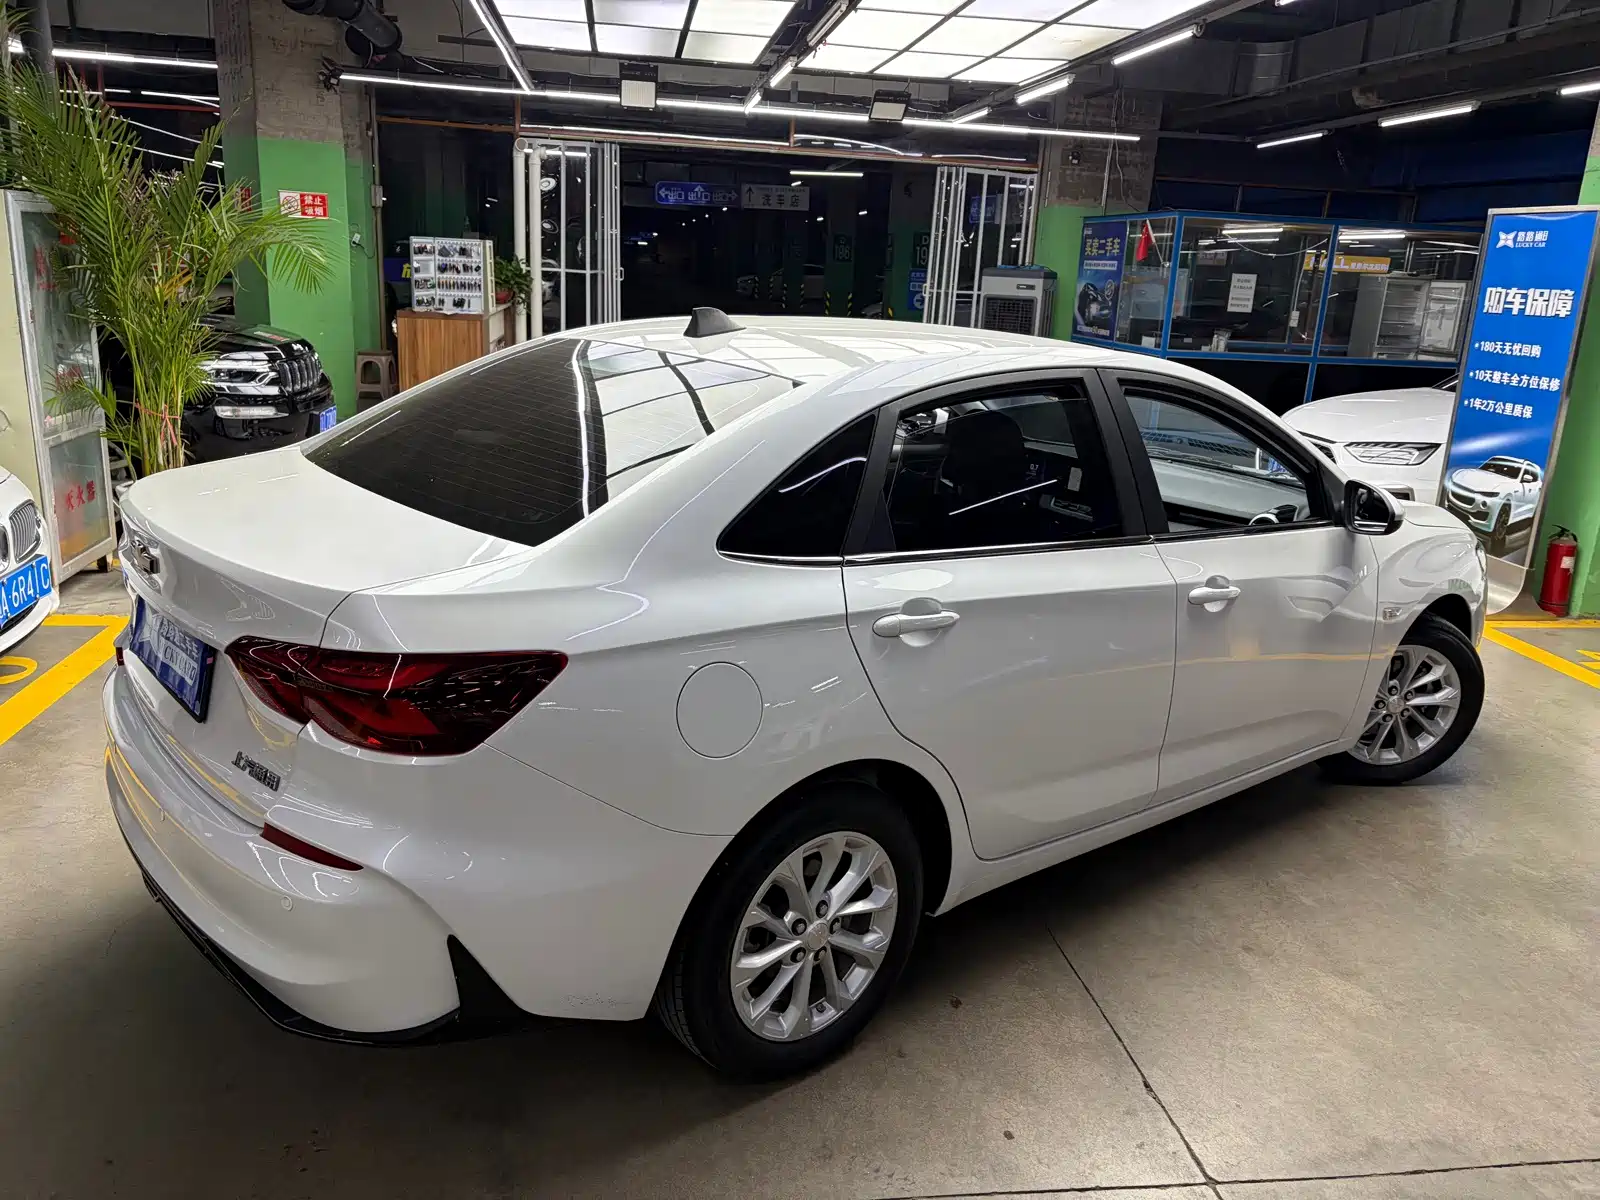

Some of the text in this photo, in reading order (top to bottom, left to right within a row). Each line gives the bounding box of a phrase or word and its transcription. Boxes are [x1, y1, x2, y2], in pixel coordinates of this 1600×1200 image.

[304, 194, 324, 205] 禁止
[304, 206, 324, 216] 吸烟
[922, 235, 929, 245] D
[1084, 237, 1121, 256] 买卖二手车
[1483, 287, 1575, 318] 购车保障
[1480, 341, 1542, 359] 180天无忧回购
[1475, 370, 1560, 392] 10天整车全方位保修
[1469, 398, 1533, 419] 1年2万公里质保
[231, 750, 281, 792] 上汽通用
